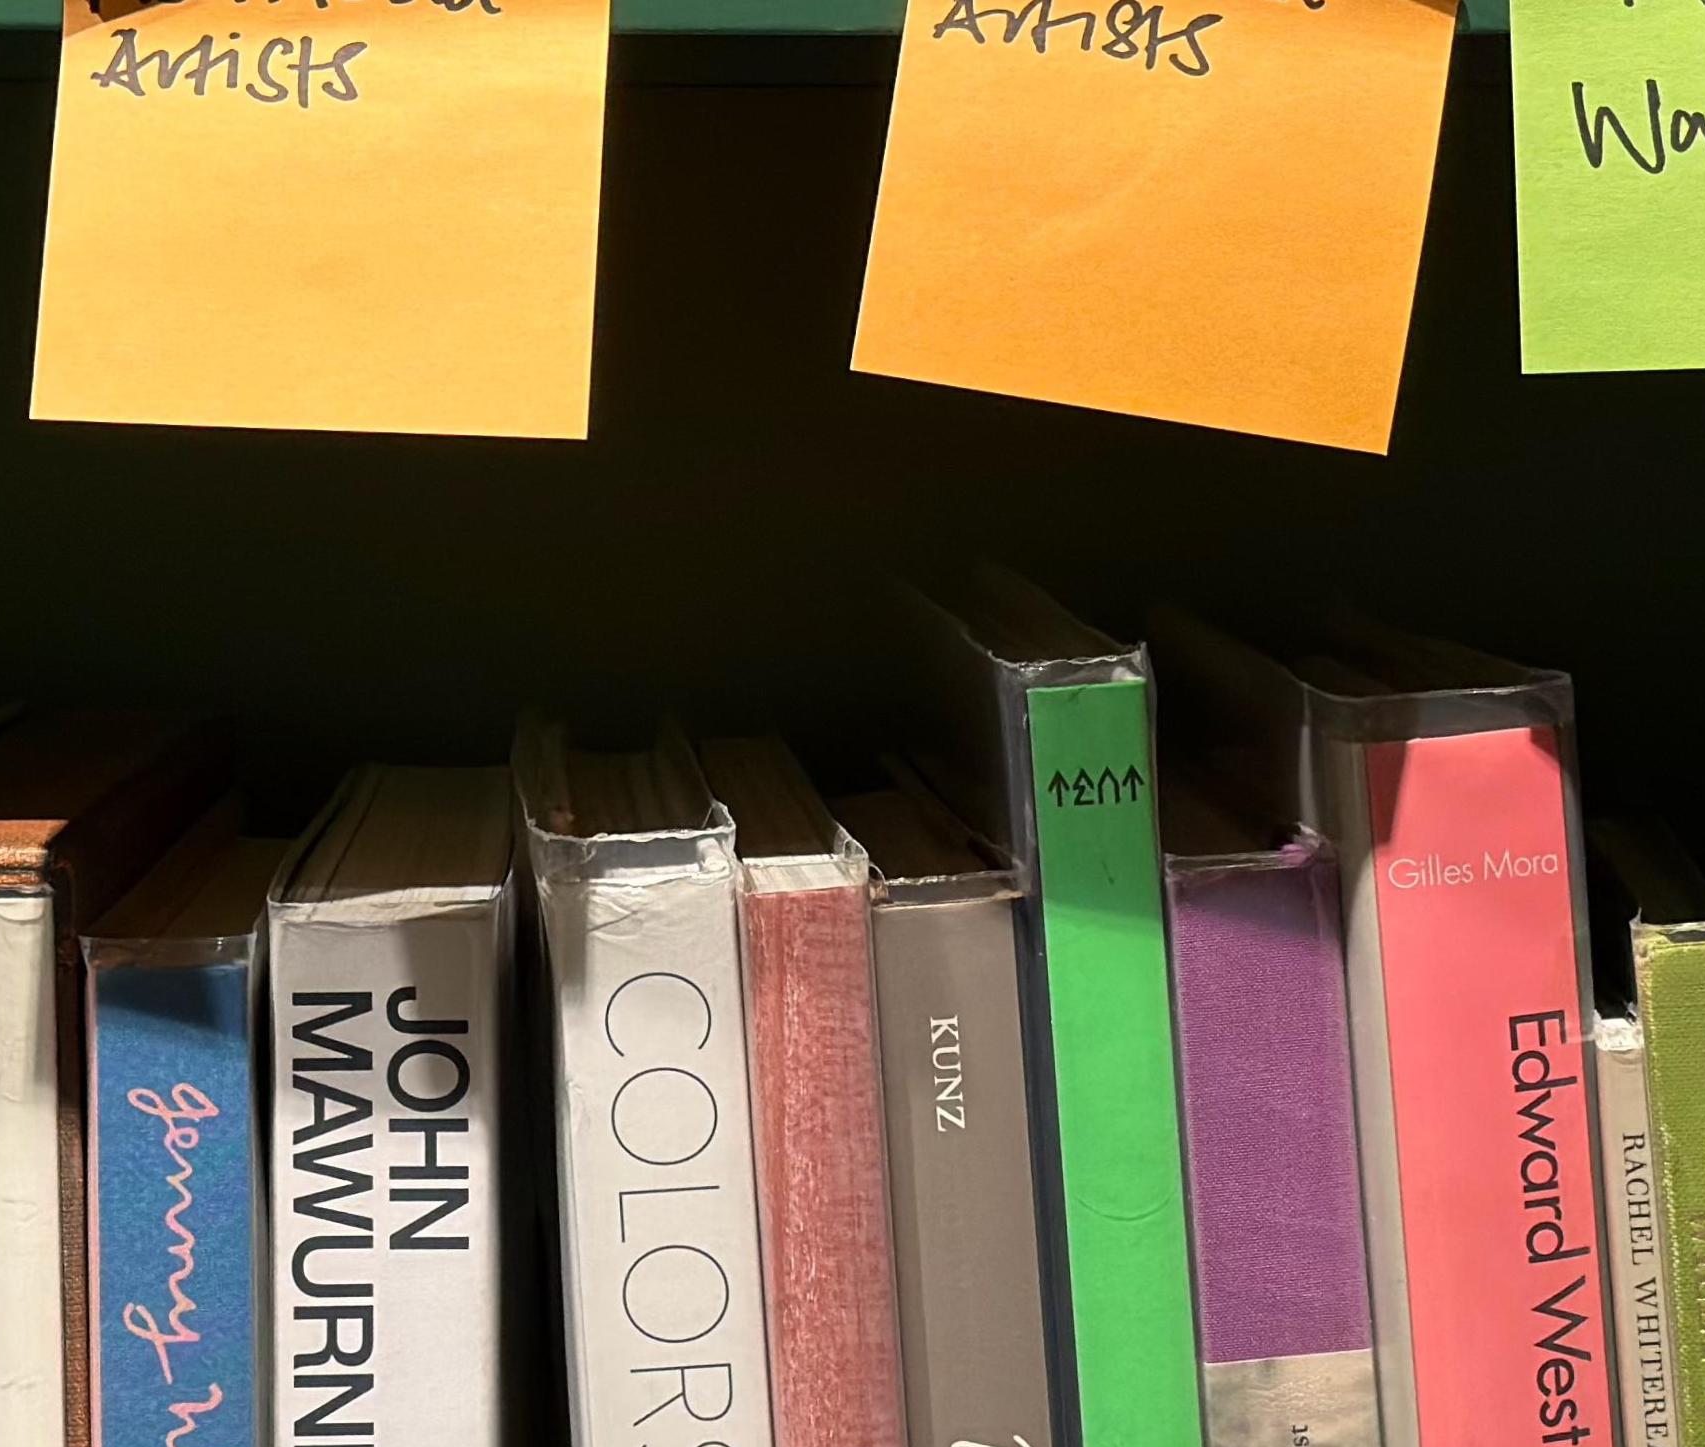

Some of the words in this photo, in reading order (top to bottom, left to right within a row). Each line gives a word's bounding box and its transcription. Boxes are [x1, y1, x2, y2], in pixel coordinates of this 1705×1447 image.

[91, 26, 364, 104] Artists
[931, 0, 1213, 78] Artists
[1388, 854, 1474, 889] Gilles
[1481, 850, 1560, 883] Mora
[386, 985, 471, 1251] JOHN
[928, 1015, 967, 1132] KUNZ
[1507, 1010, 1591, 1264] Edward
[1623, 1132, 1654, 1265] RACHEL
